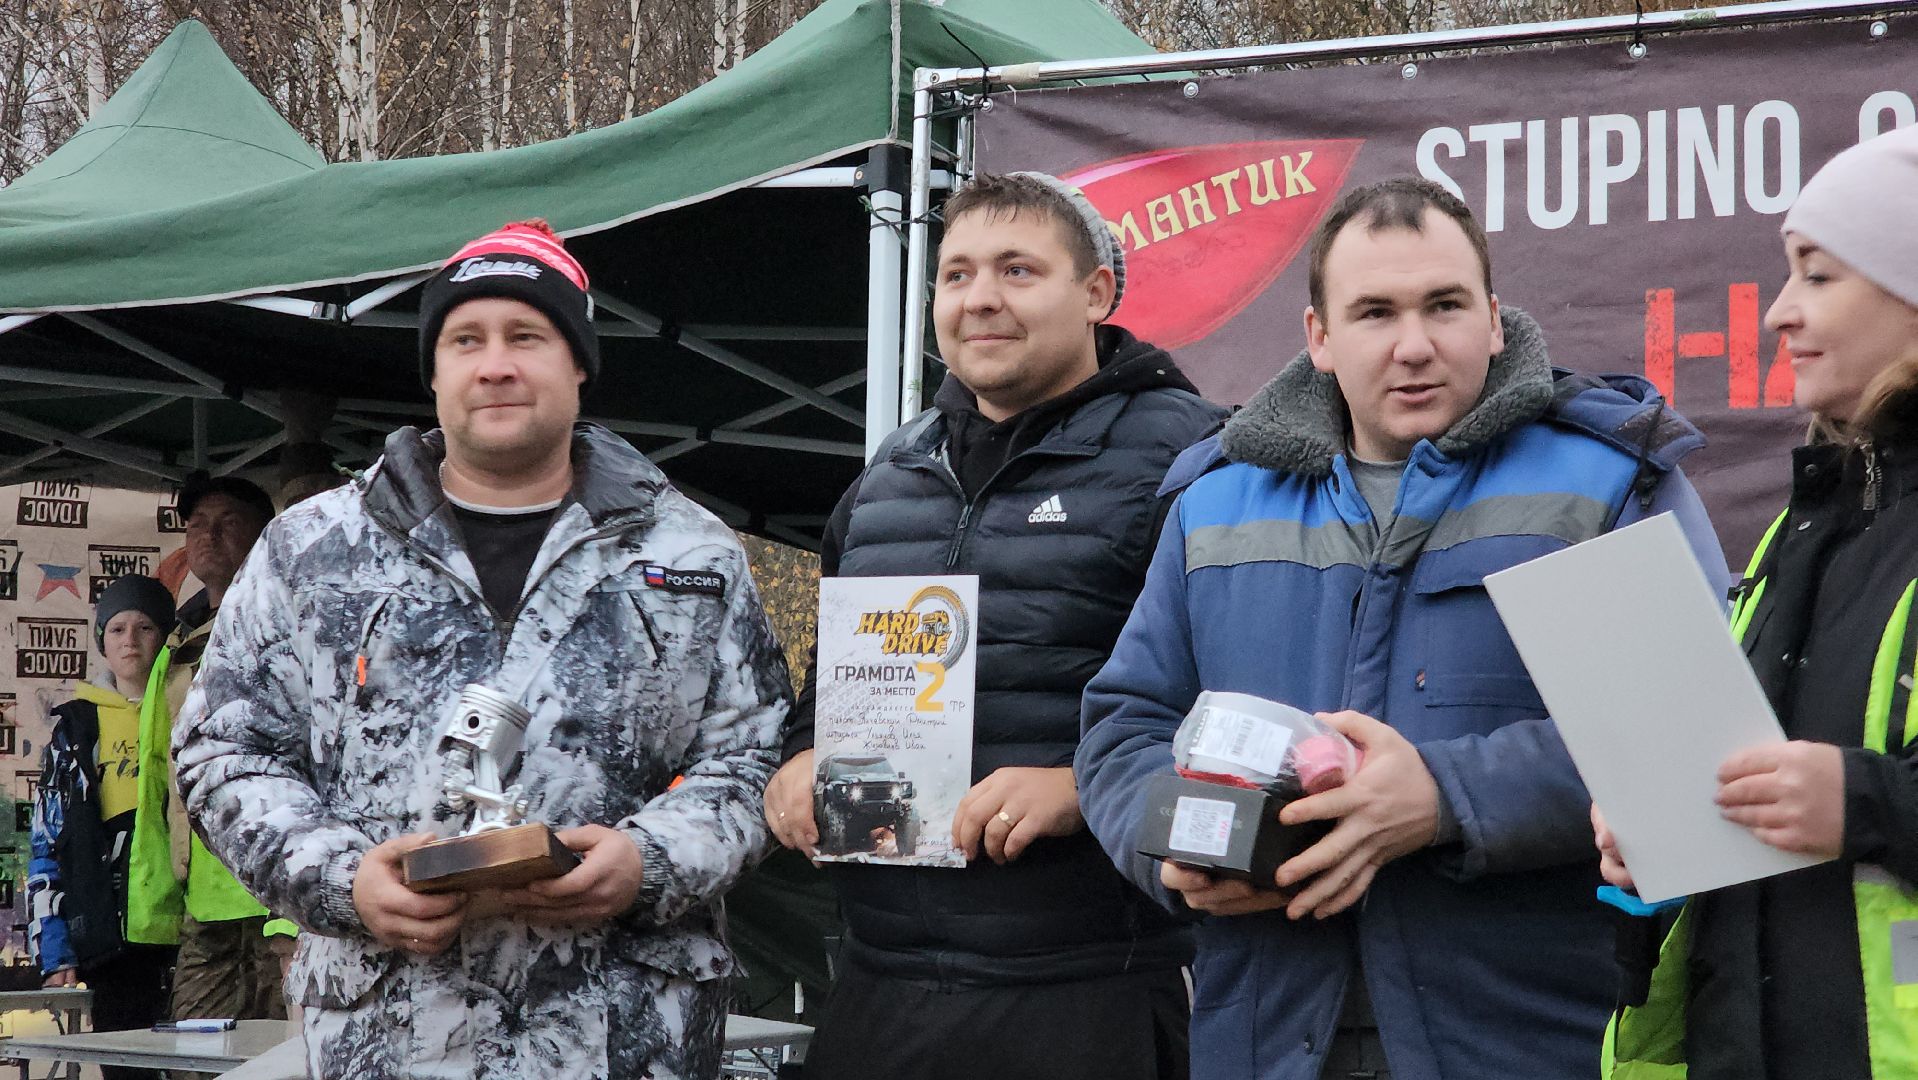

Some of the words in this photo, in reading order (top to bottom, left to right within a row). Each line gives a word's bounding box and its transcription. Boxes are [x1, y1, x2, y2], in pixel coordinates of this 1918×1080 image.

[1415, 100, 1801, 232] STUPINO
[1105, 151, 1316, 250] МАНТИК
[1028, 511, 1067, 523] adidas
[666, 573, 721, 588] РОССИЯ
[855, 610, 920, 636] HARD
[882, 631, 952, 657] DRIVE
[834, 665, 916, 682] ГРАМОТА
[870, 686, 882, 696] ЗА
[885, 686, 916, 696] МЕСТО
[914, 662, 945, 712] 2
